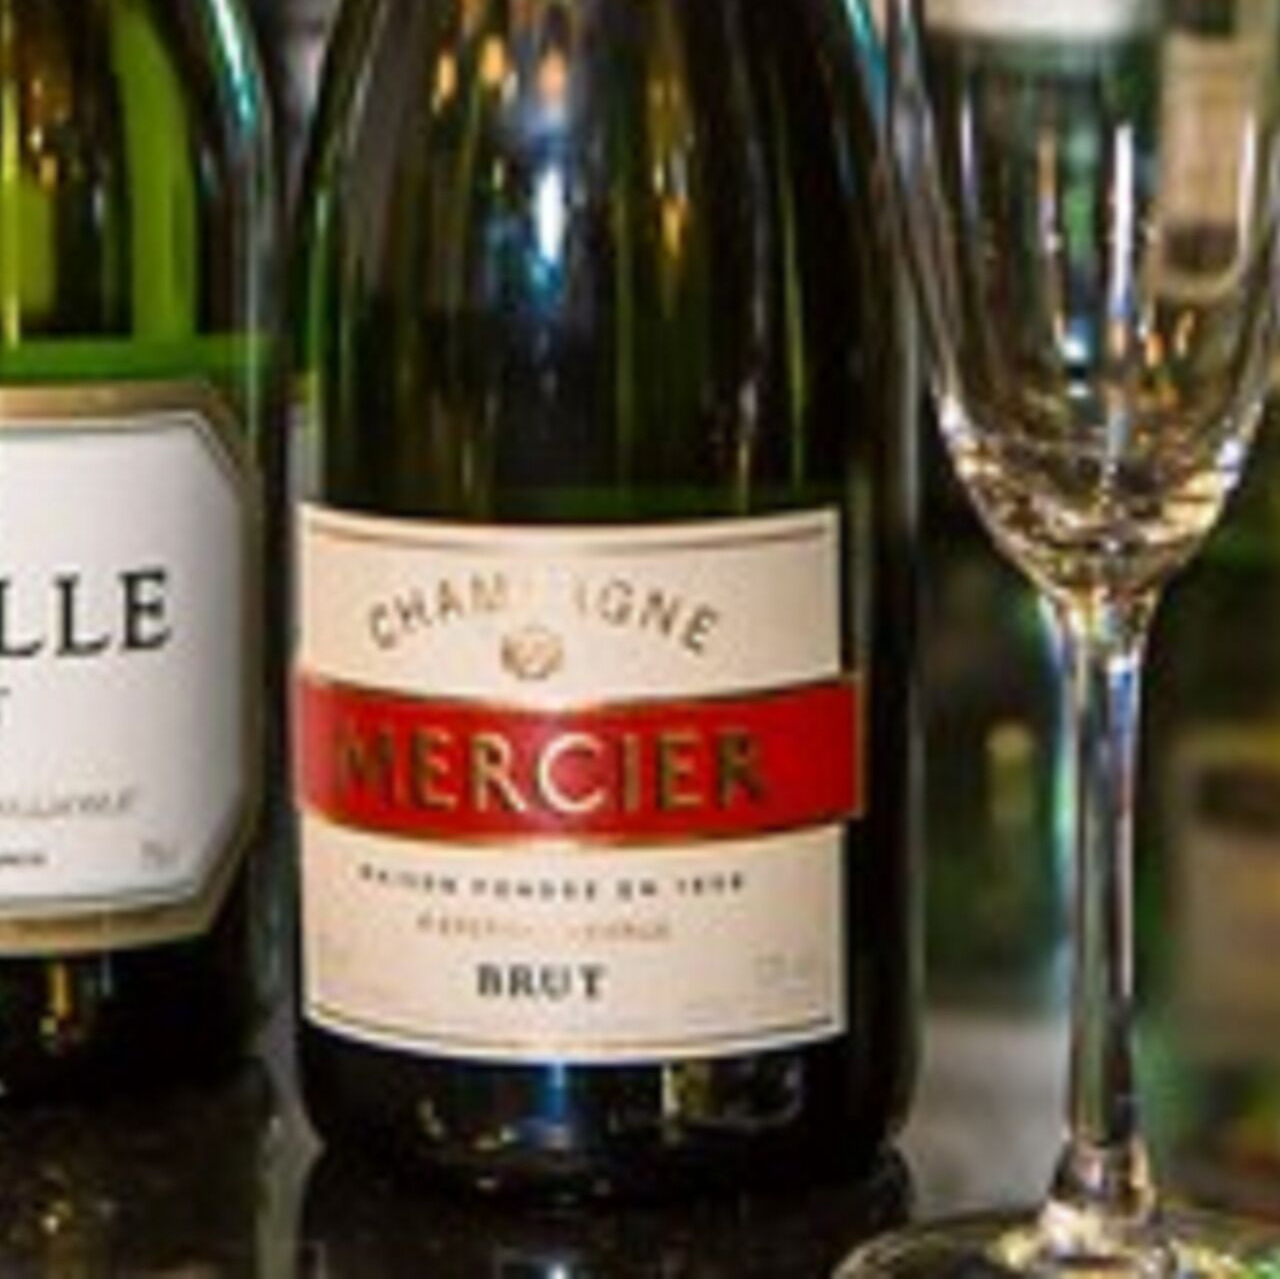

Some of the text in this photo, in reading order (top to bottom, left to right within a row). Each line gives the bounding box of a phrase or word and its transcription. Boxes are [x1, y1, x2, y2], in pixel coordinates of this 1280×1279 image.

[369, 570, 719, 656] CHAMGNE
[332, 724, 766, 815] MERCIER
[476, 963, 606, 1000] BRUT
